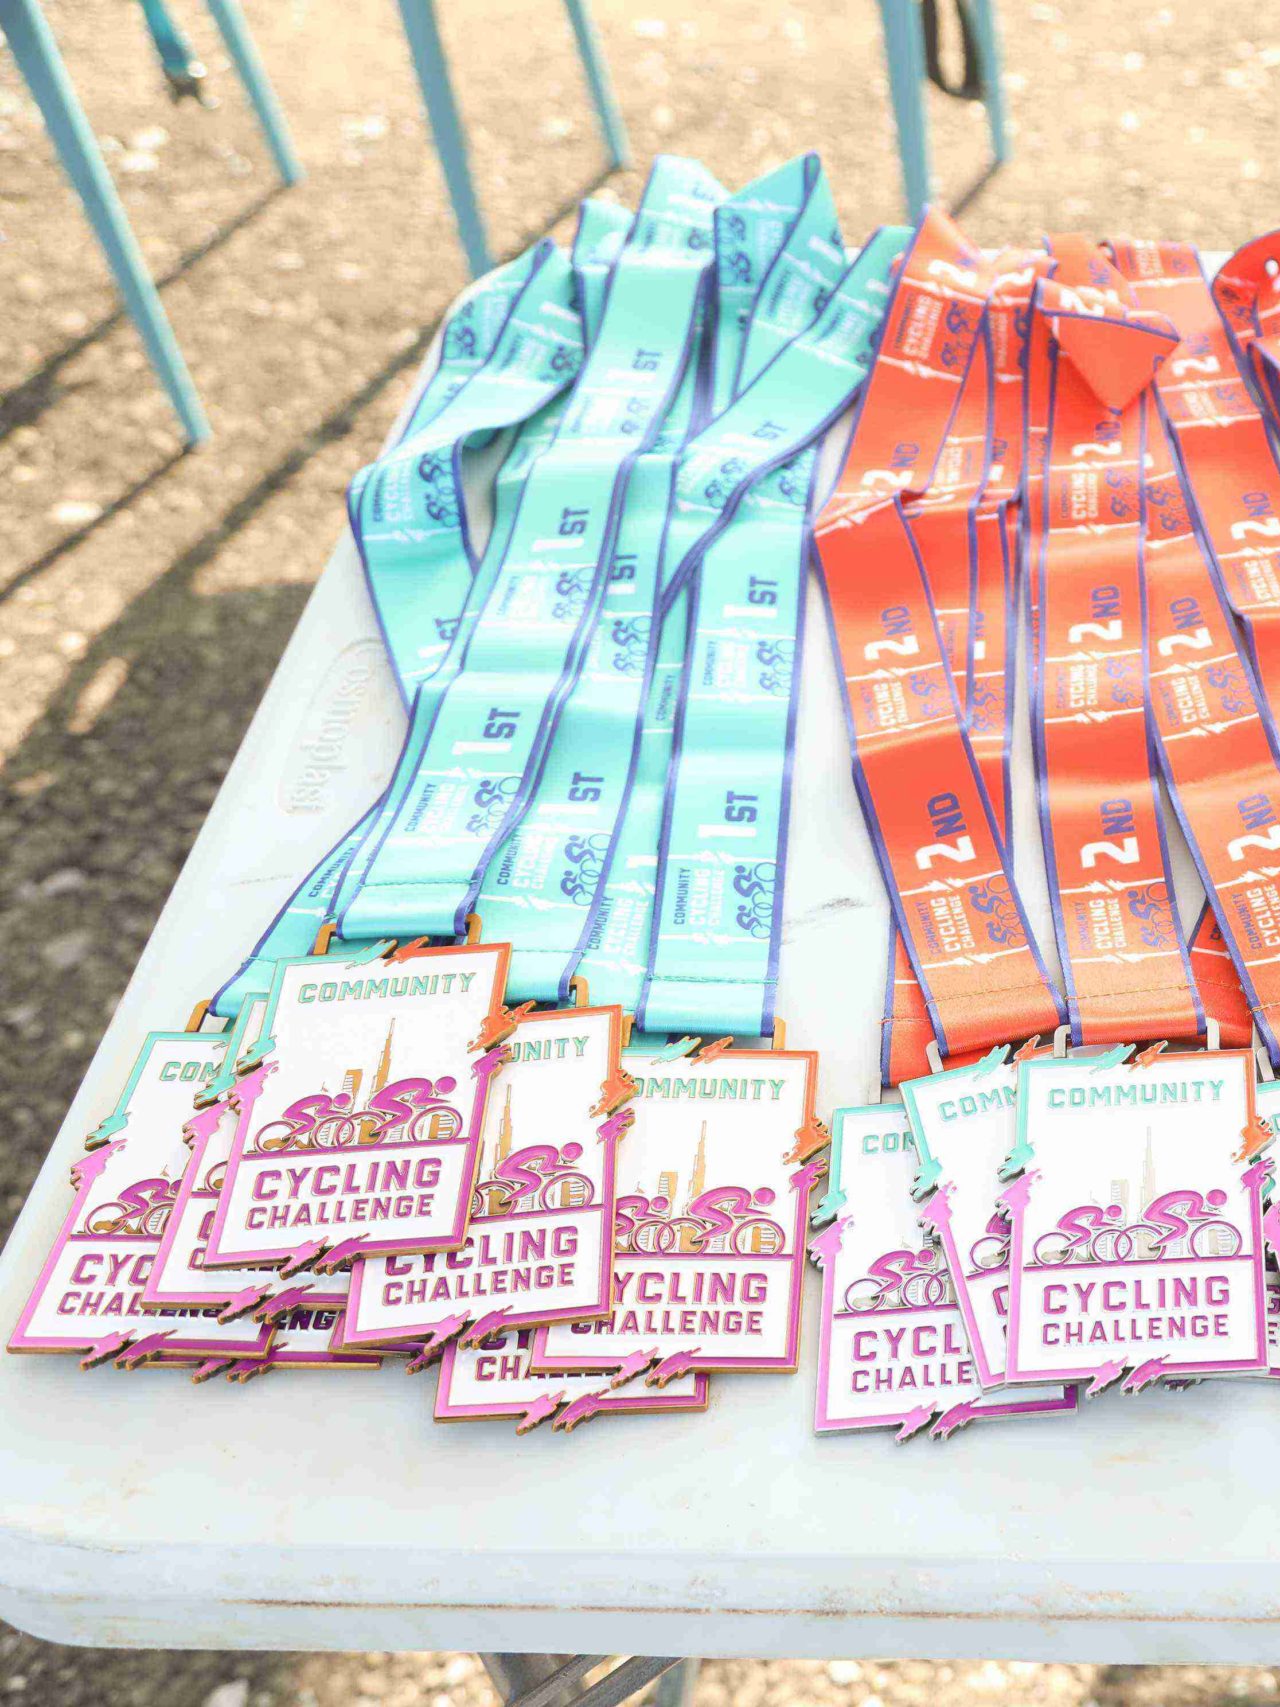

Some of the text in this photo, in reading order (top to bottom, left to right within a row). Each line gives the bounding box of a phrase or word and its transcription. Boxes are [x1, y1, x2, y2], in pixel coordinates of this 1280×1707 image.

[531, 507, 590, 551] 1ST
[608, 552, 637, 595] 1ST
[723, 577, 778, 617] 1ST
[864, 606, 920, 661] 2ND
[1068, 585, 1124, 643] 2ND
[1157, 597, 1213, 656] 2ND
[452, 708, 520, 755] 1ST
[405, 783, 437, 832] COMMUNITY
[537, 772, 604, 815] 1ST
[698, 791, 758, 838] 1ST
[916, 792, 976, 869] 2ND
[1080, 799, 1140, 868] 2ND
[498, 832, 523, 885] COMMUNITY
[674, 868, 691, 925] COMMUNITY
[1246, 887, 1280, 945] CYCLING
[588, 896, 614, 950] COMMUNITY
[916, 900, 944, 955] COMMUNITY
[931, 896, 963, 953] CYCLING
[949, 894, 976, 948] CHALLENGE
[1087, 900, 1111, 950] CYCLING
[1105, 898, 1127, 947] CHALLENGE
[1232, 893, 1263, 950] COMMUNITY
[298, 972, 476, 1004] COMMUNITY
[511, 1036, 590, 1062] UNITY
[634, 1077, 786, 1100] OMMUNITY
[1047, 1080, 1225, 1109] COMMUNITY
[252, 1157, 442, 1202] CYCLING
[245, 1193, 434, 1231] CHALLENGE
[385, 1226, 579, 1276] CYCLING
[382, 1262, 575, 1306] CHALLENGE
[616, 1272, 768, 1304] YCLING
[1042, 1275, 1231, 1316] CYCLING
[851, 1323, 968, 1362] CYCL
[1042, 1313, 1230, 1346] CHALLENGE
[851, 1361, 972, 1393] CHALLE
